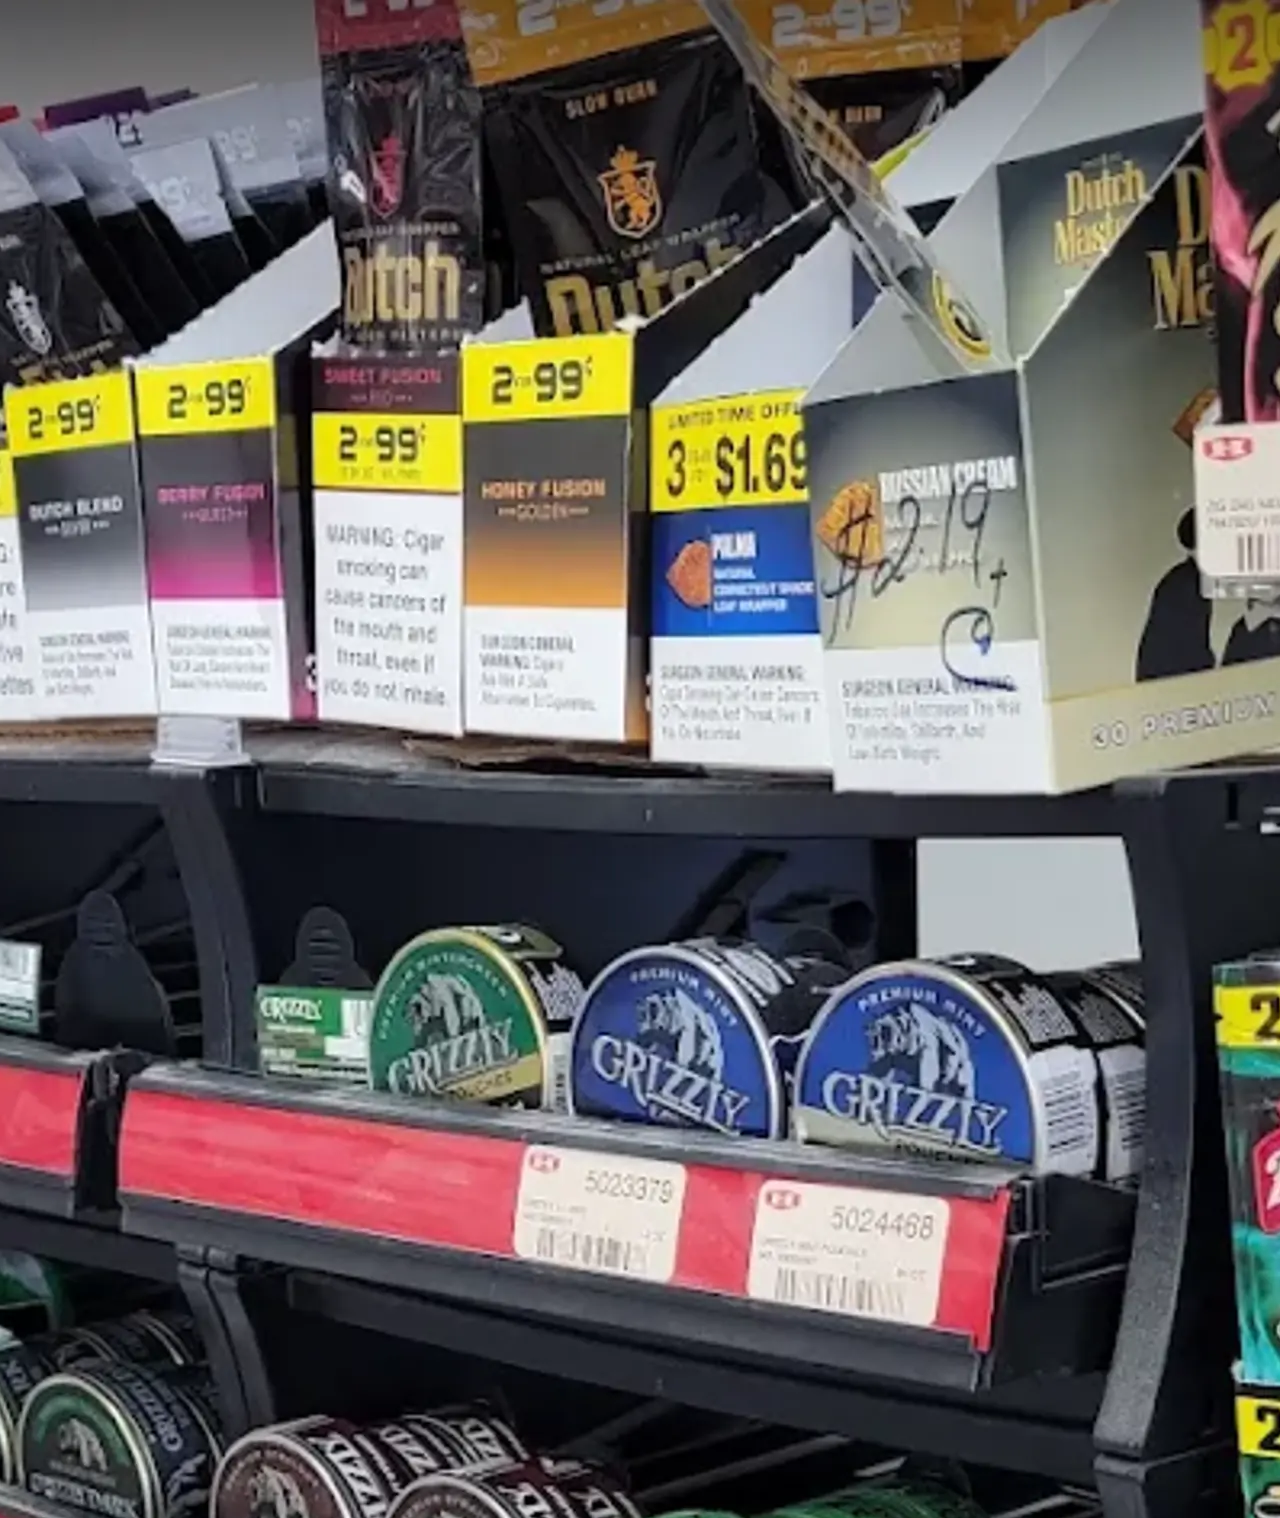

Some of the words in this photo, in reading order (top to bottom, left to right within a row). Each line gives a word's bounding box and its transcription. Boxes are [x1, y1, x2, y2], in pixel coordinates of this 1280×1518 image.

[566, 94, 609, 121] SLOW
[1064, 160, 1147, 216] Dutch
[324, 368, 375, 385] SWEET
[380, 367, 442, 384] FUSION
[717, 406, 755, 425] TIME
[760, 401, 803, 419] OFF
[666, 438, 687, 498] 3
[715, 431, 809, 500] $1.69
[481, 480, 535, 500] HONEY
[541, 478, 606, 498] FUSION
[76, 496, 124, 516] BLEND
[325, 523, 398, 548] WARNING:
[404, 528, 446, 554] Cigar
[337, 558, 396, 583] smoking
[400, 563, 429, 581] can
[324, 589, 366, 609] cause
[432, 593, 447, 613] of
[334, 616, 355, 636] the
[359, 619, 402, 642] mouth
[407, 624, 438, 644] and
[324, 679, 347, 700] you
[351, 680, 370, 698] do
[375, 683, 398, 703] not
[1091, 721, 1129, 750] 30
[1142, 694, 1274, 744] PREMIUM
[389, 1024, 518, 1098] GRIZZLY
[590, 1033, 751, 1138] GRIZZLY
[821, 1070, 1008, 1157] GRIZZLY
